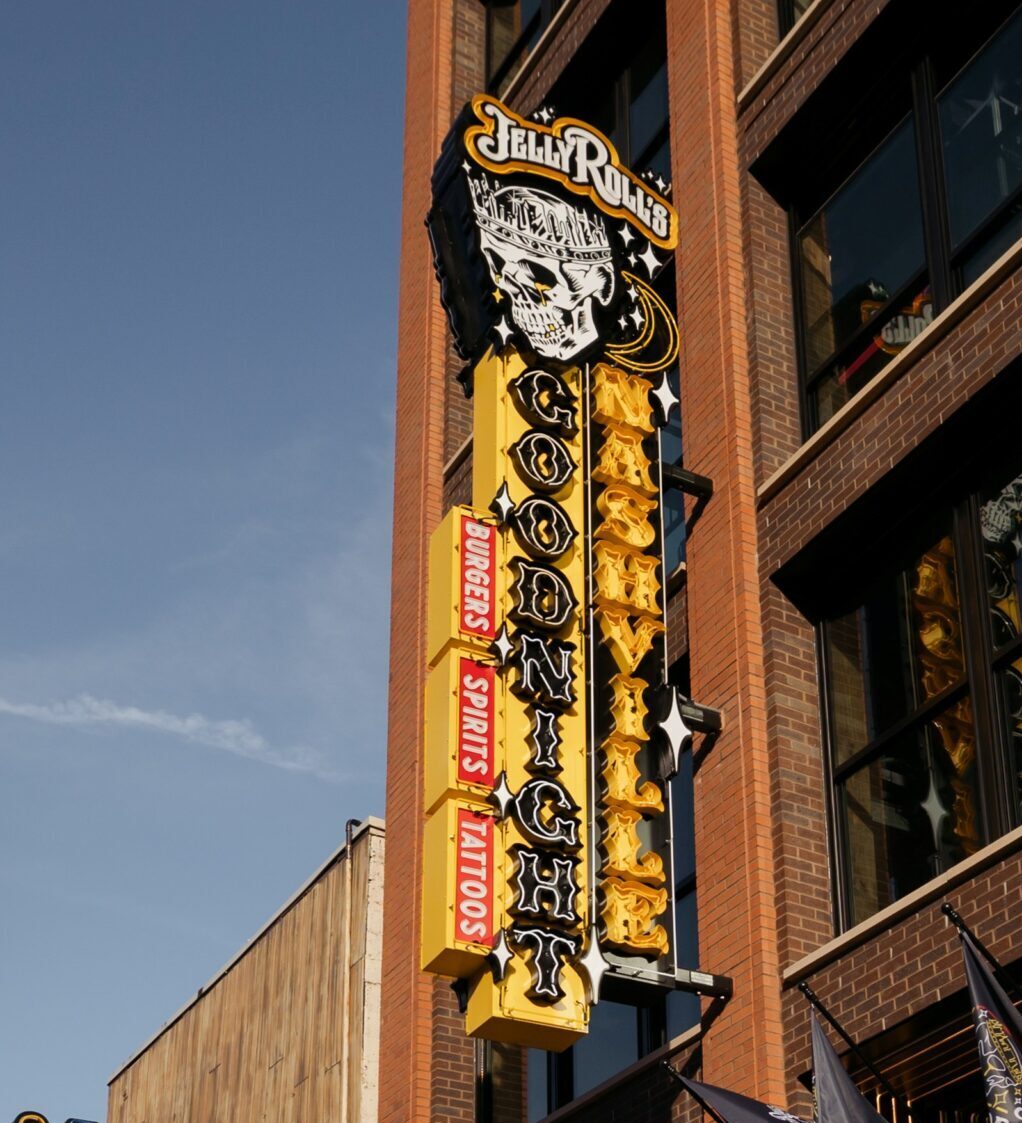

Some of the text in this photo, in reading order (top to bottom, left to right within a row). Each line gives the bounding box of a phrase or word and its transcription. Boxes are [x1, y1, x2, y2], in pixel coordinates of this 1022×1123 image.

[461, 519, 490, 634] BURGERS
[506, 369, 584, 1002] GOODNIGHT
[592, 363, 669, 957] NASHVILLE
[460, 673, 490, 777] SPIRITS
[459, 820, 489, 938] TATTOOS
